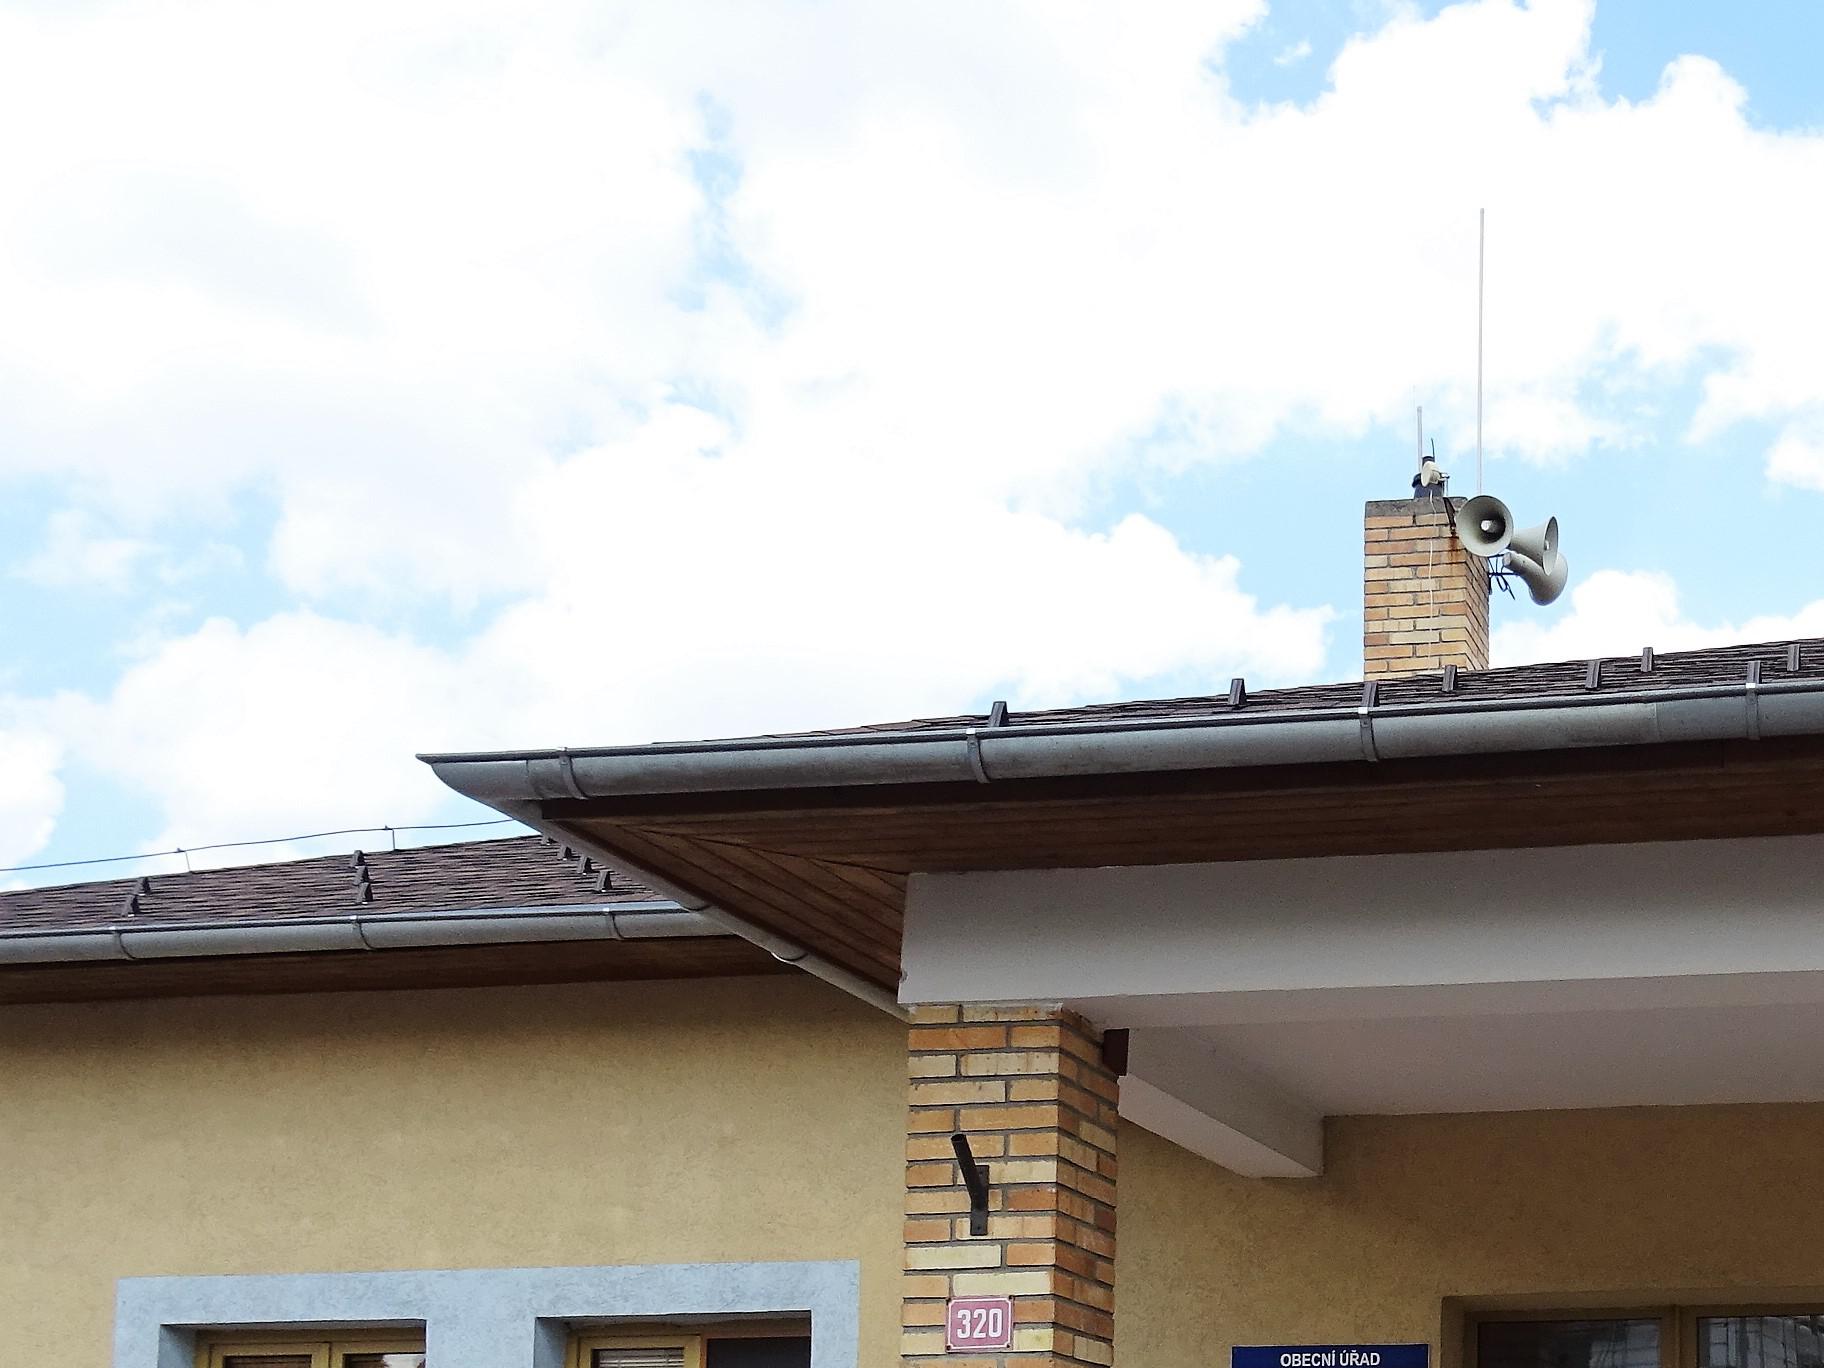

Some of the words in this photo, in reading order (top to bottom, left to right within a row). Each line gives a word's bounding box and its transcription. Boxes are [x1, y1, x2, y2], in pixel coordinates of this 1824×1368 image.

[957, 1308, 1003, 1339] 320
[1280, 1350, 1336, 1367] OBECNÍ
[1339, 1349, 1381, 1366] ÚŘAD
